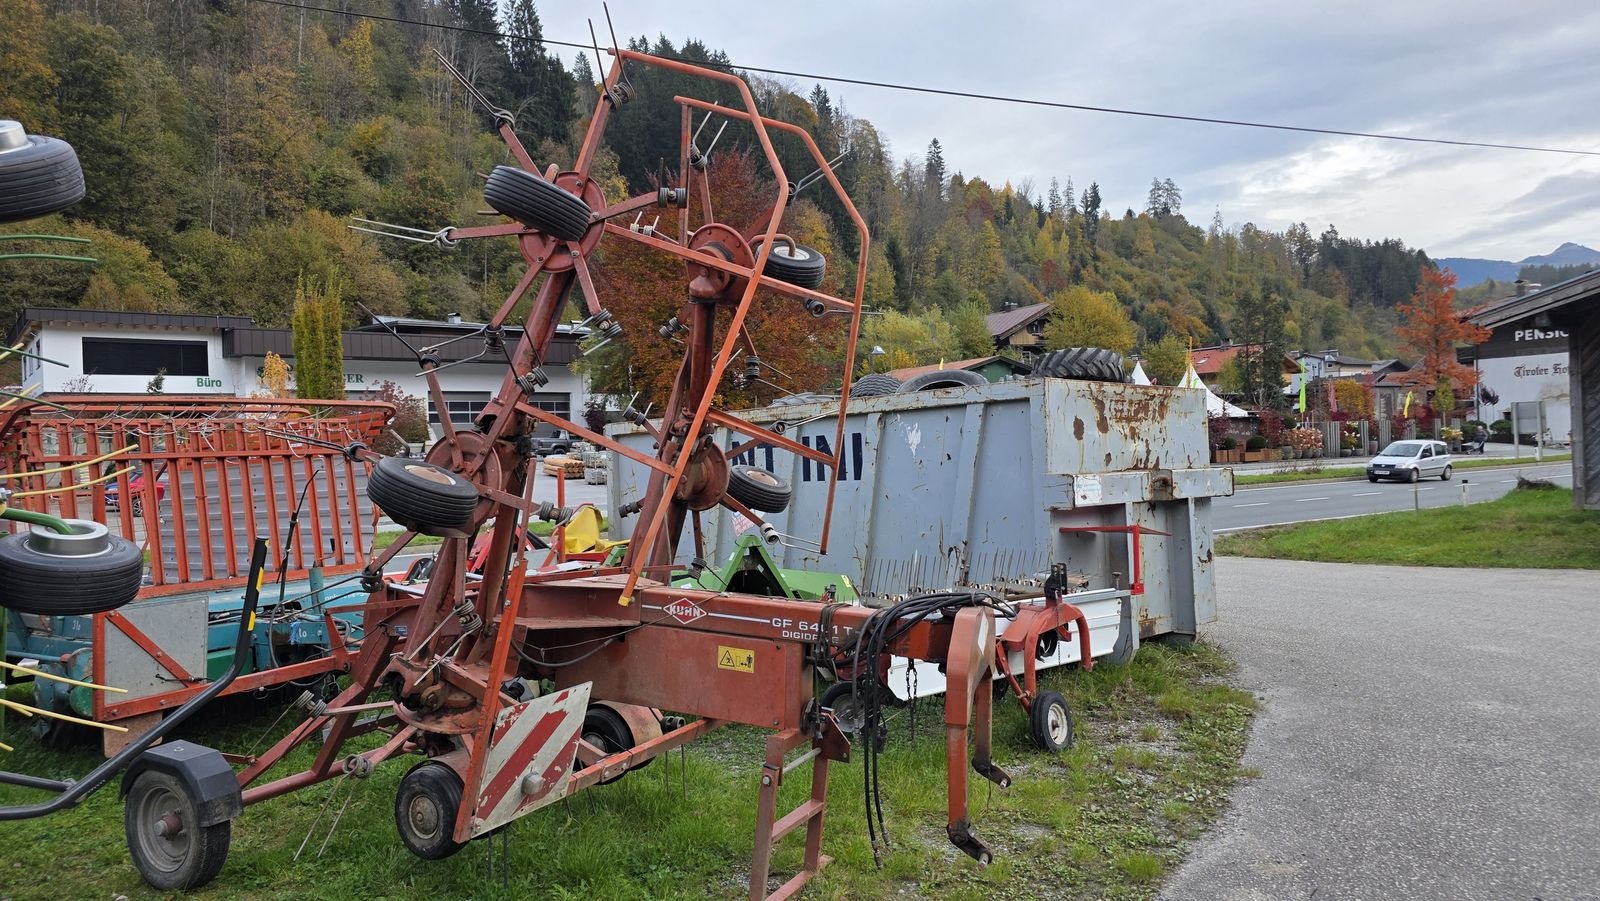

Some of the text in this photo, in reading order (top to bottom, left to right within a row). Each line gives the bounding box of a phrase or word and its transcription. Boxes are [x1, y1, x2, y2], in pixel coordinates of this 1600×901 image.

[1552, 363, 1568, 376] Ho
[196, 377, 222, 388] Büro
[343, 373, 364, 384] ER
[669, 605, 701, 618] KUHN
[772, 618, 793, 631] GF
